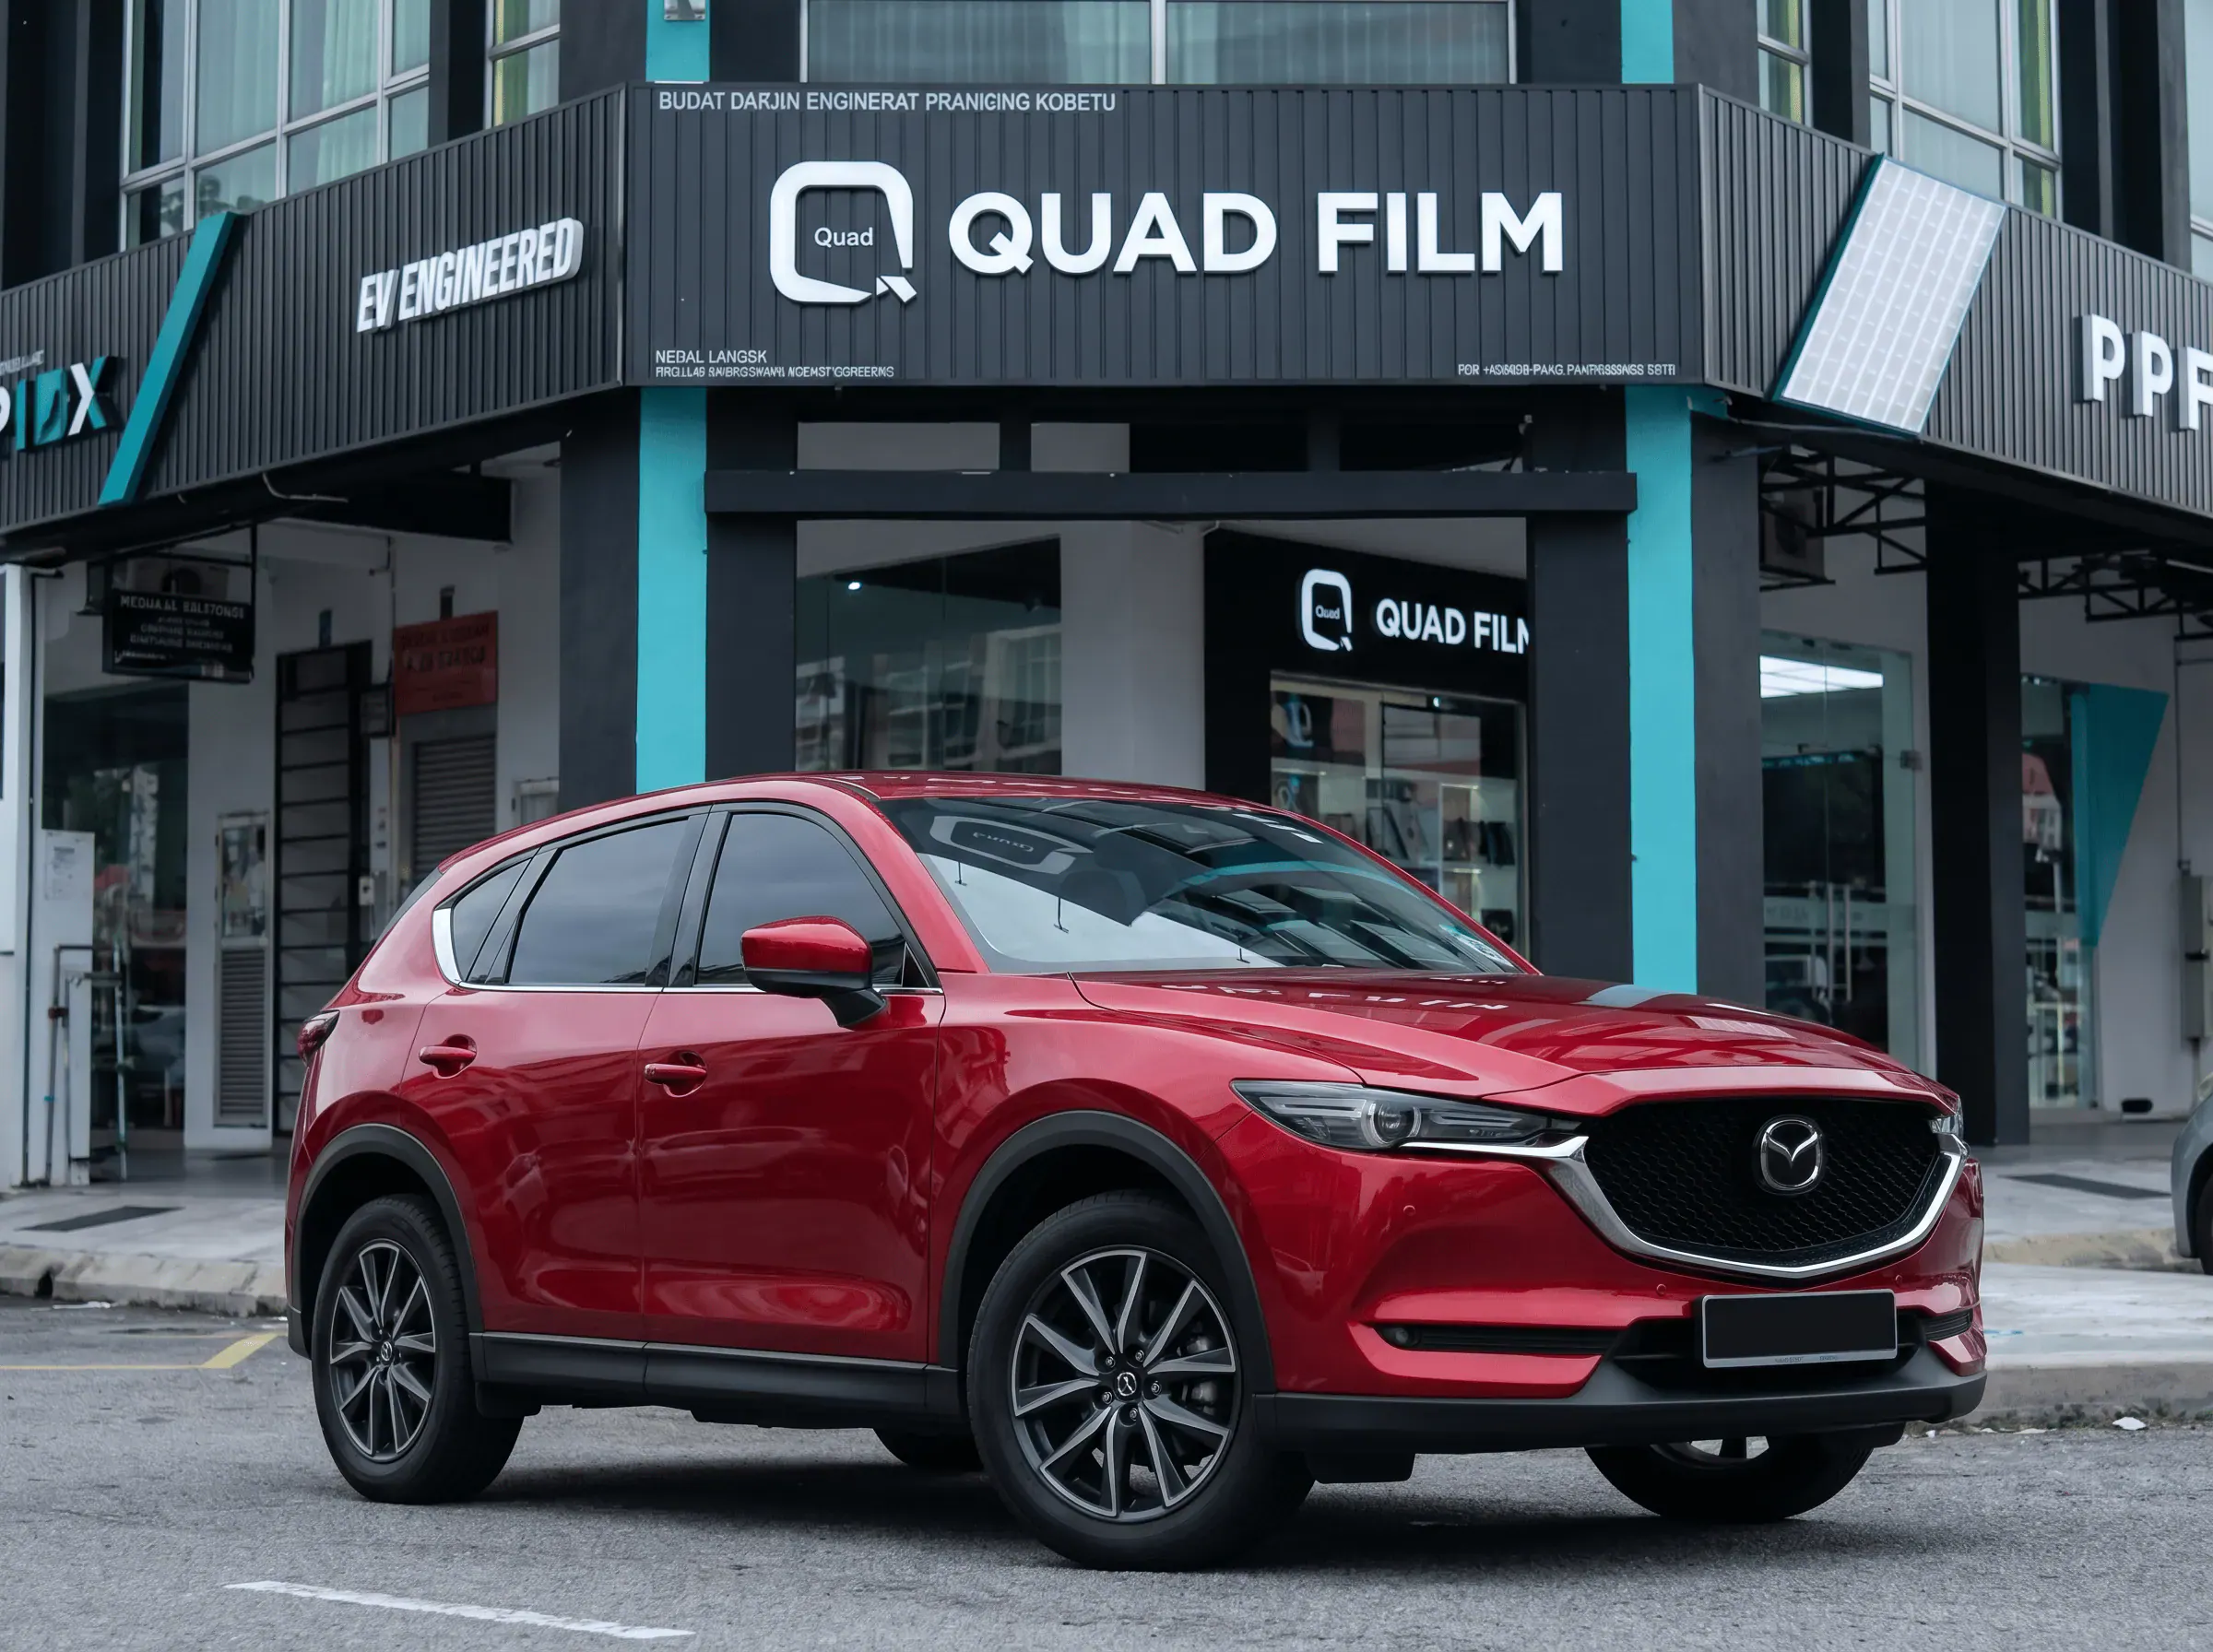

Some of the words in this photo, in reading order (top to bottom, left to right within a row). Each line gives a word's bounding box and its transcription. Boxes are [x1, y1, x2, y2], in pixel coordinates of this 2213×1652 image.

[659, 91, 726, 110] BUDAT
[806, 91, 919, 111] ENGINERAT
[1035, 93, 1116, 112] KOBETU
[814, 227, 873, 248] Quad
[948, 191, 1278, 276] QUAD
[1318, 192, 1563, 274] FILM
[356, 269, 399, 333] EV
[398, 217, 584, 322] ENGINEERED
[708, 349, 767, 363] LANGSK
[1376, 598, 1466, 645] QUAD
